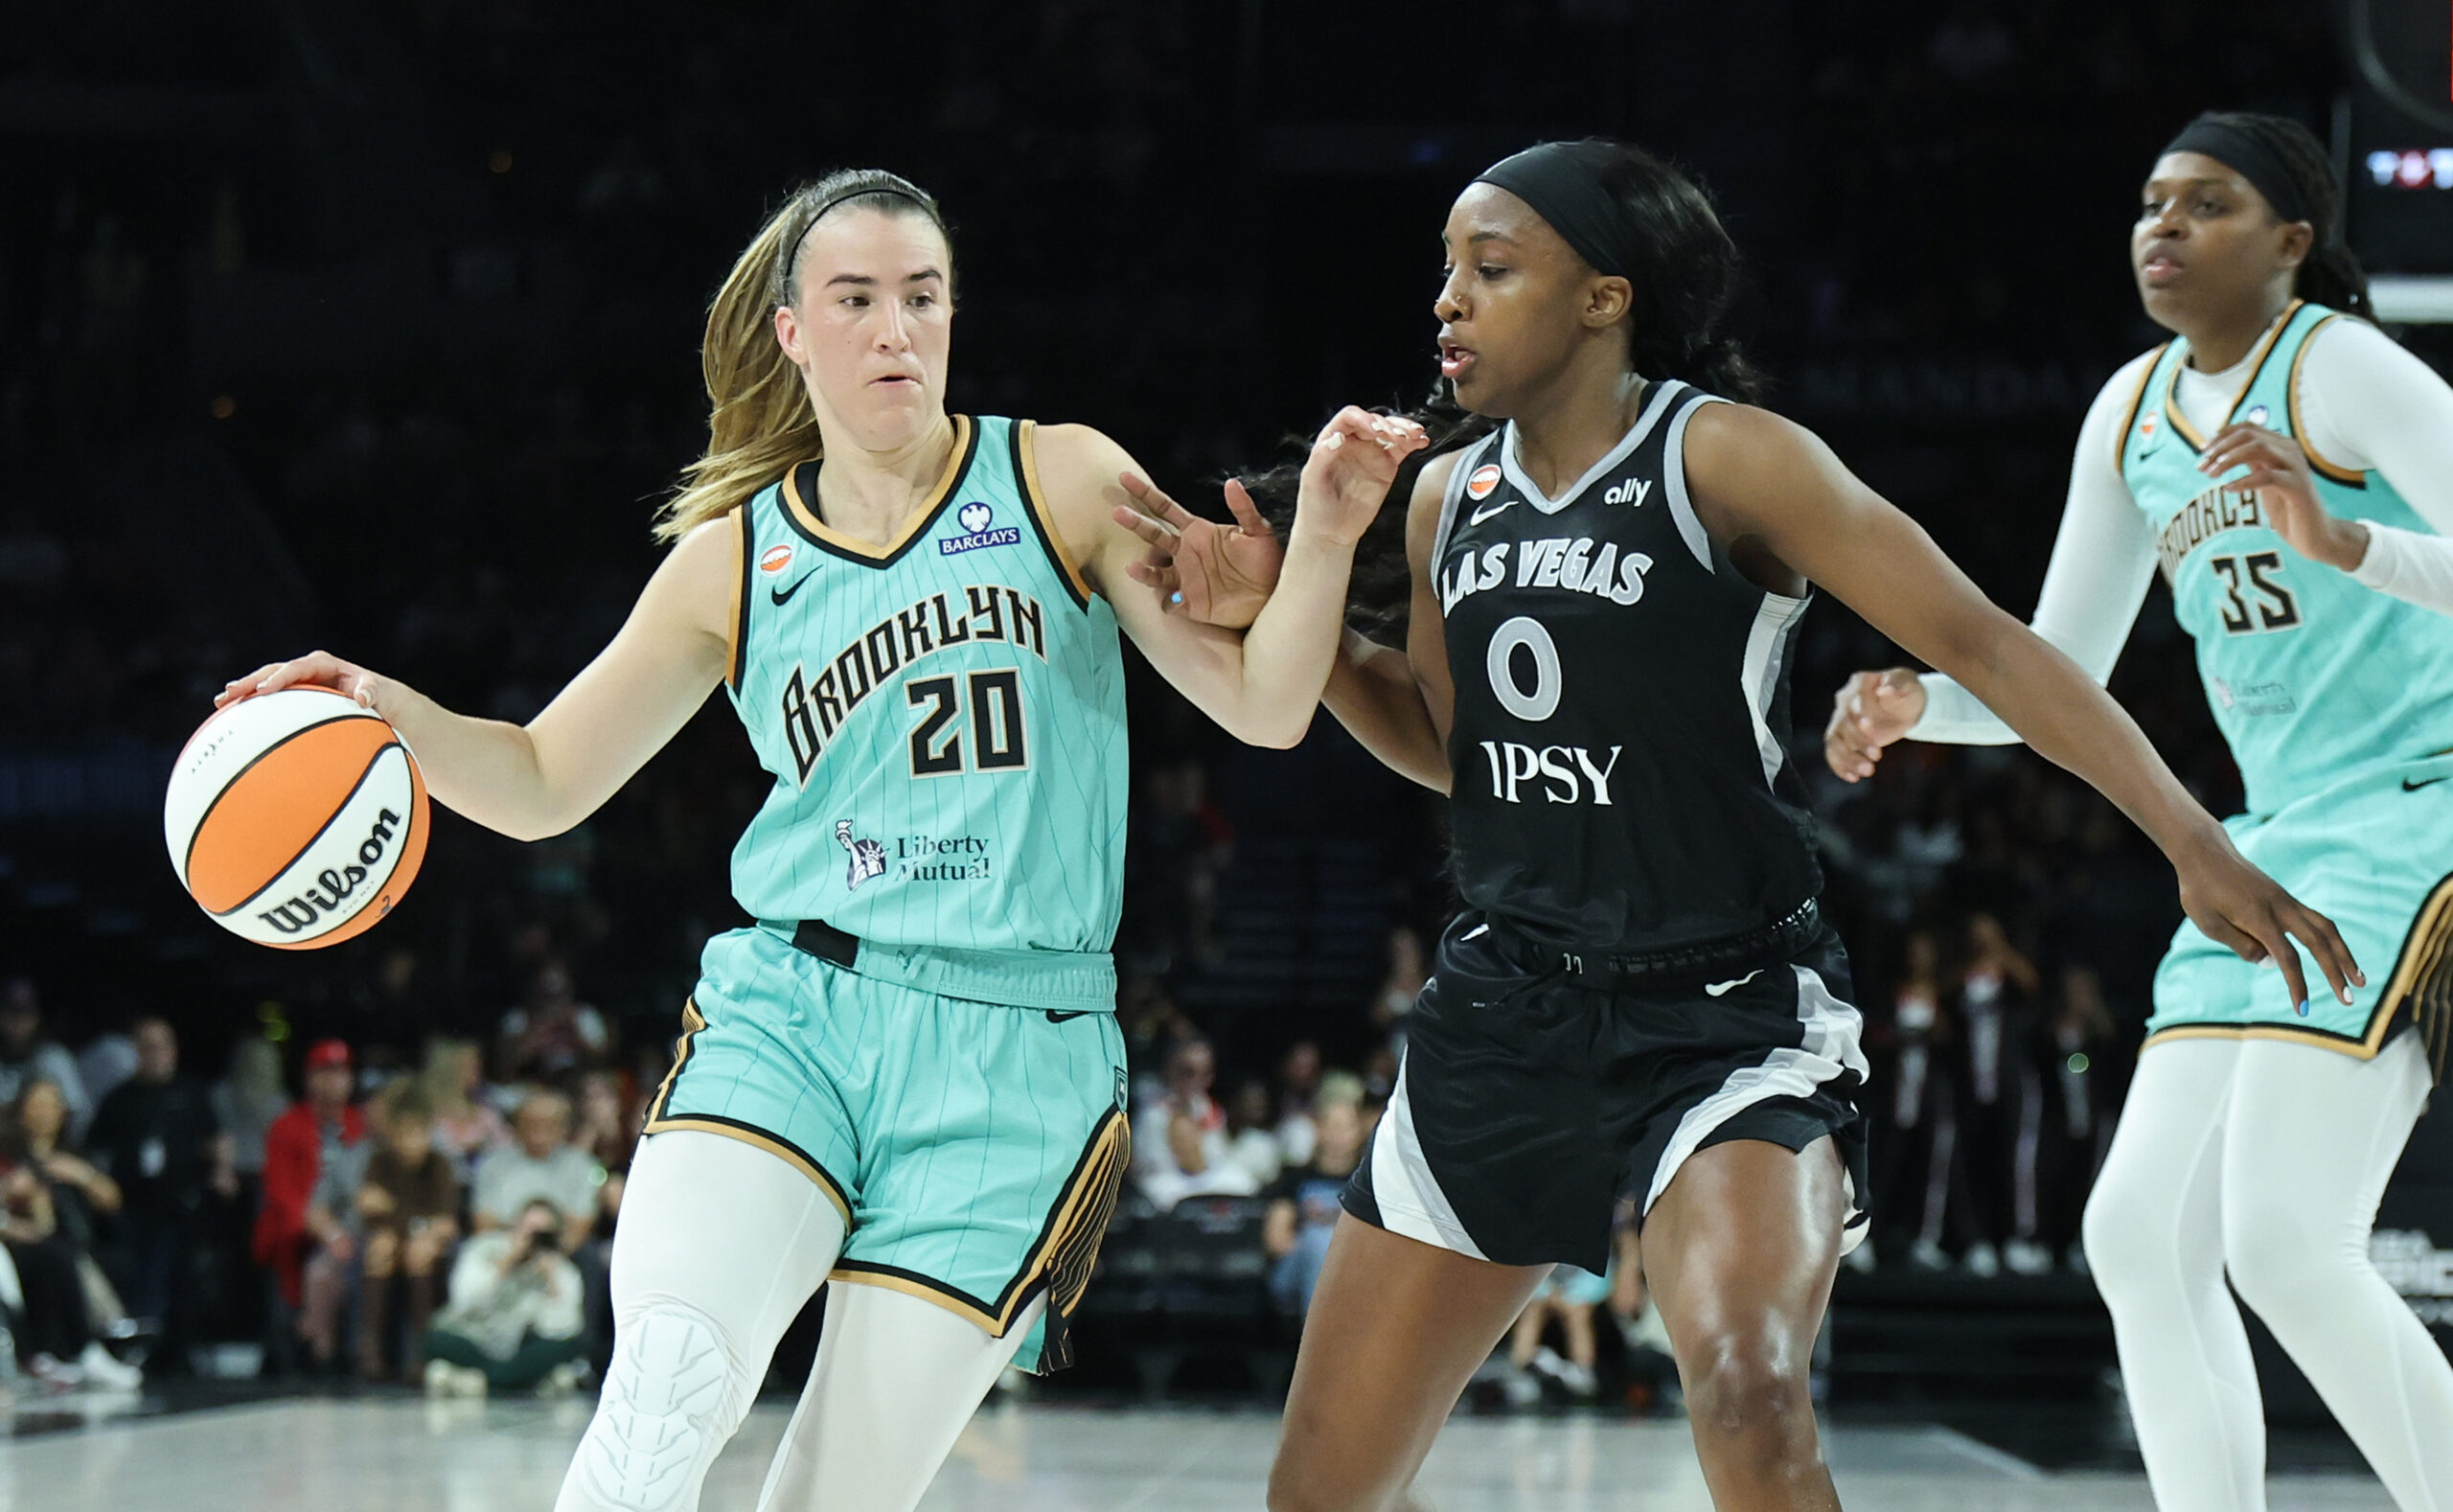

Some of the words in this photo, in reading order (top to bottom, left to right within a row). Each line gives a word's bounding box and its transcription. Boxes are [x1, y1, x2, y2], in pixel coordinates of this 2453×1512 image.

[1604, 477, 1652, 508] ally
[942, 528, 1018, 554] BARCLAYS
[1441, 542, 1511, 619] LAS
[1515, 537, 1654, 606] VEGAS
[2209, 549, 2303, 637] 35
[782, 584, 1048, 792] BROOKLYN
[1487, 615, 1563, 722] 0
[904, 666, 1030, 780] 20
[1479, 740, 1623, 806] IPSY
[257, 806, 401, 934] Wilson
[895, 858, 991, 881] Mutual
[896, 834, 989, 862] Liberty
